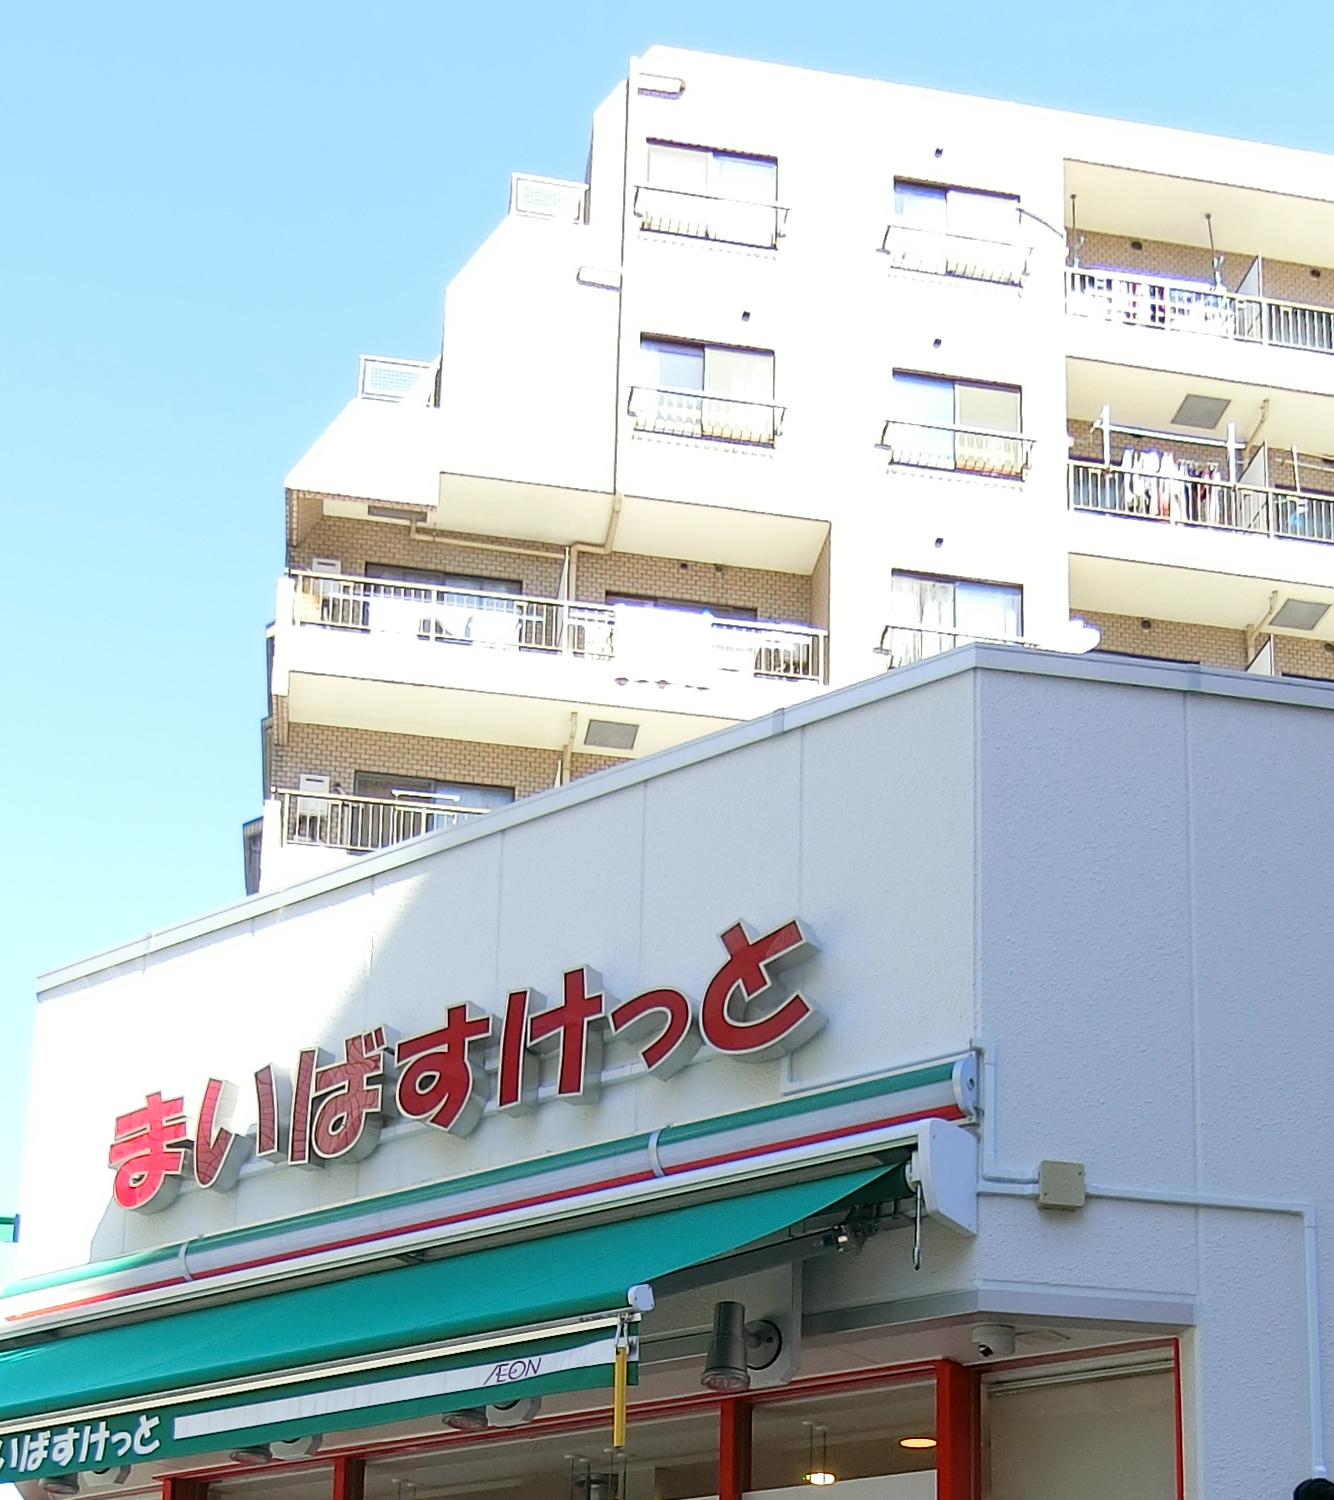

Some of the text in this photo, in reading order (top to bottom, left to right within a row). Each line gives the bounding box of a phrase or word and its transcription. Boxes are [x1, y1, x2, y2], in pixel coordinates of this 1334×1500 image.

[109, 917, 817, 1211] まいばすけっと
